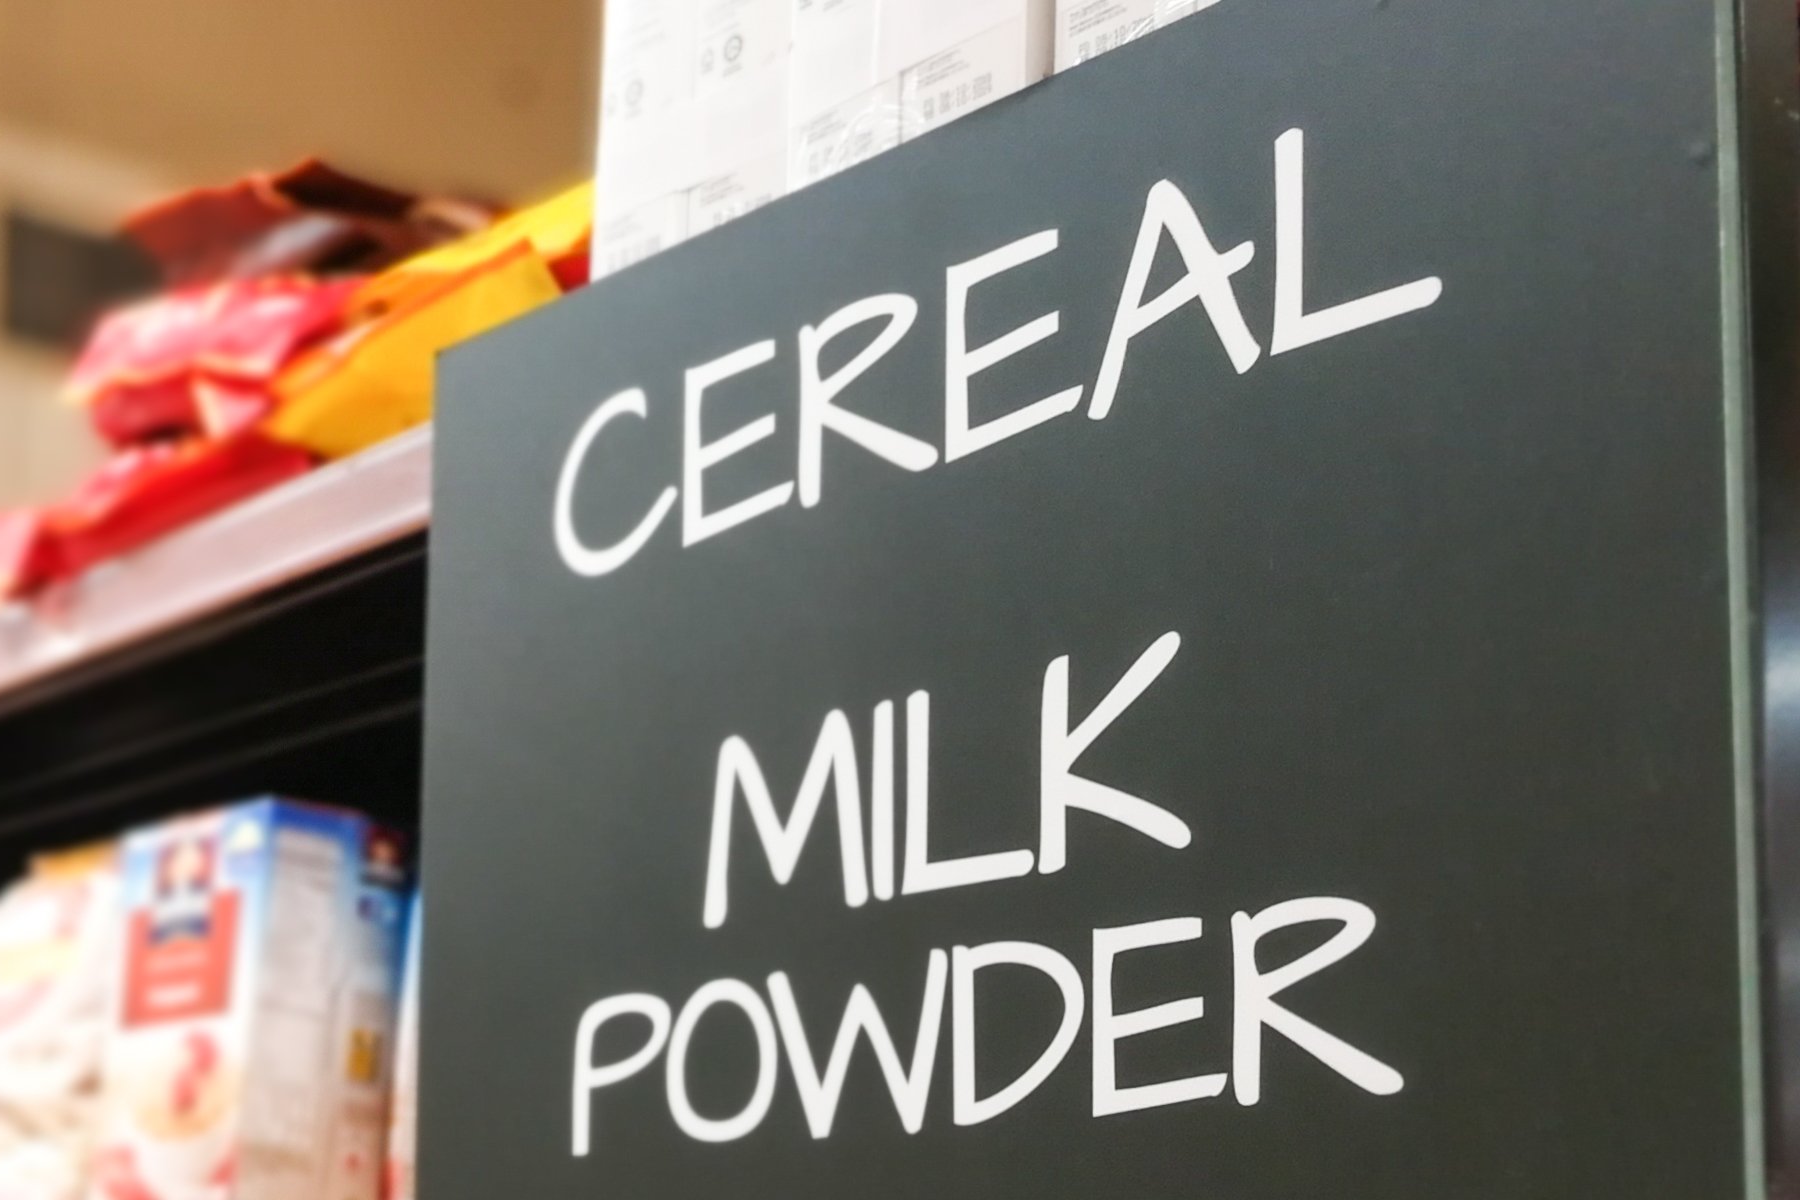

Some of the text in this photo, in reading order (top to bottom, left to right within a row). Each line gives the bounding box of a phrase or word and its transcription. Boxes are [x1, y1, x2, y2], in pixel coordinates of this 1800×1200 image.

[551, 127, 1443, 578] CEREAL
[702, 630, 1192, 929] MILK
[572, 896, 1404, 1157] POWDER
